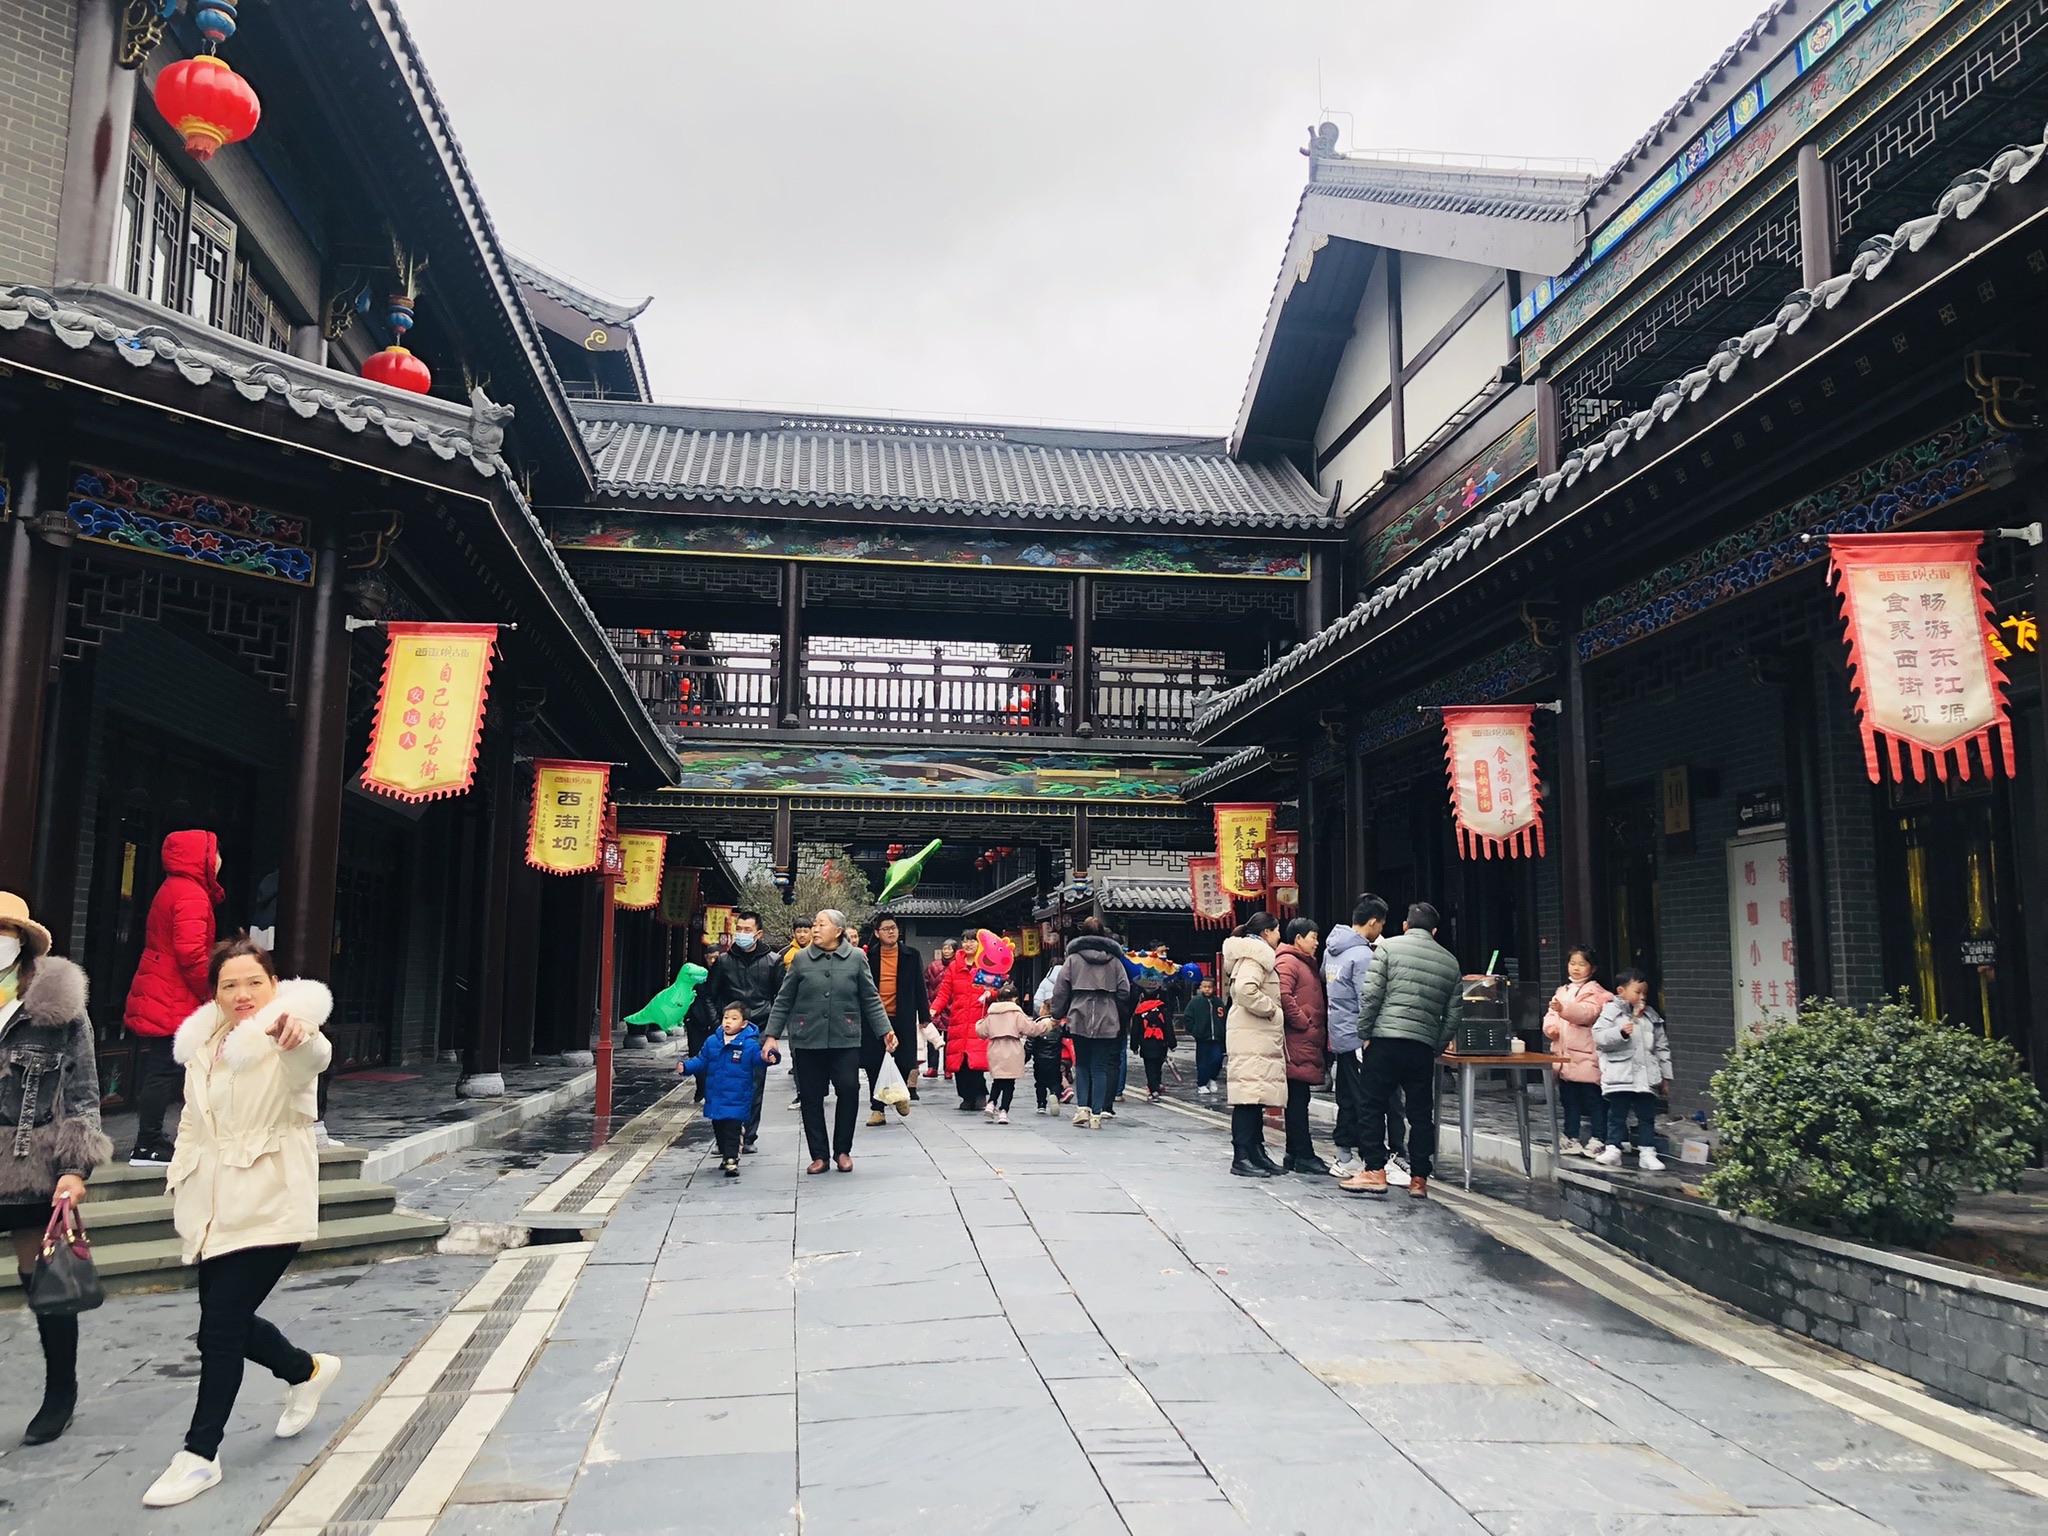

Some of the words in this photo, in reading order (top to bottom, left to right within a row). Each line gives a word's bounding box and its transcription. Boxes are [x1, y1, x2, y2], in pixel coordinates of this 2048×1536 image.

[1878, 567, 1950, 582] 西街坝古街
[1882, 592, 1929, 724] 食聚西街坝
[1920, 592, 1968, 724] 畅游东江源
[400, 687, 424, 747] 安远人
[419, 662, 453, 781] 自己的古街
[1492, 746, 1517, 825] 食尚同行
[552, 791, 582, 851] 西街坝
[1217, 1006, 1225, 1018] S
[1751, 979, 1797, 1008] 养生茶
